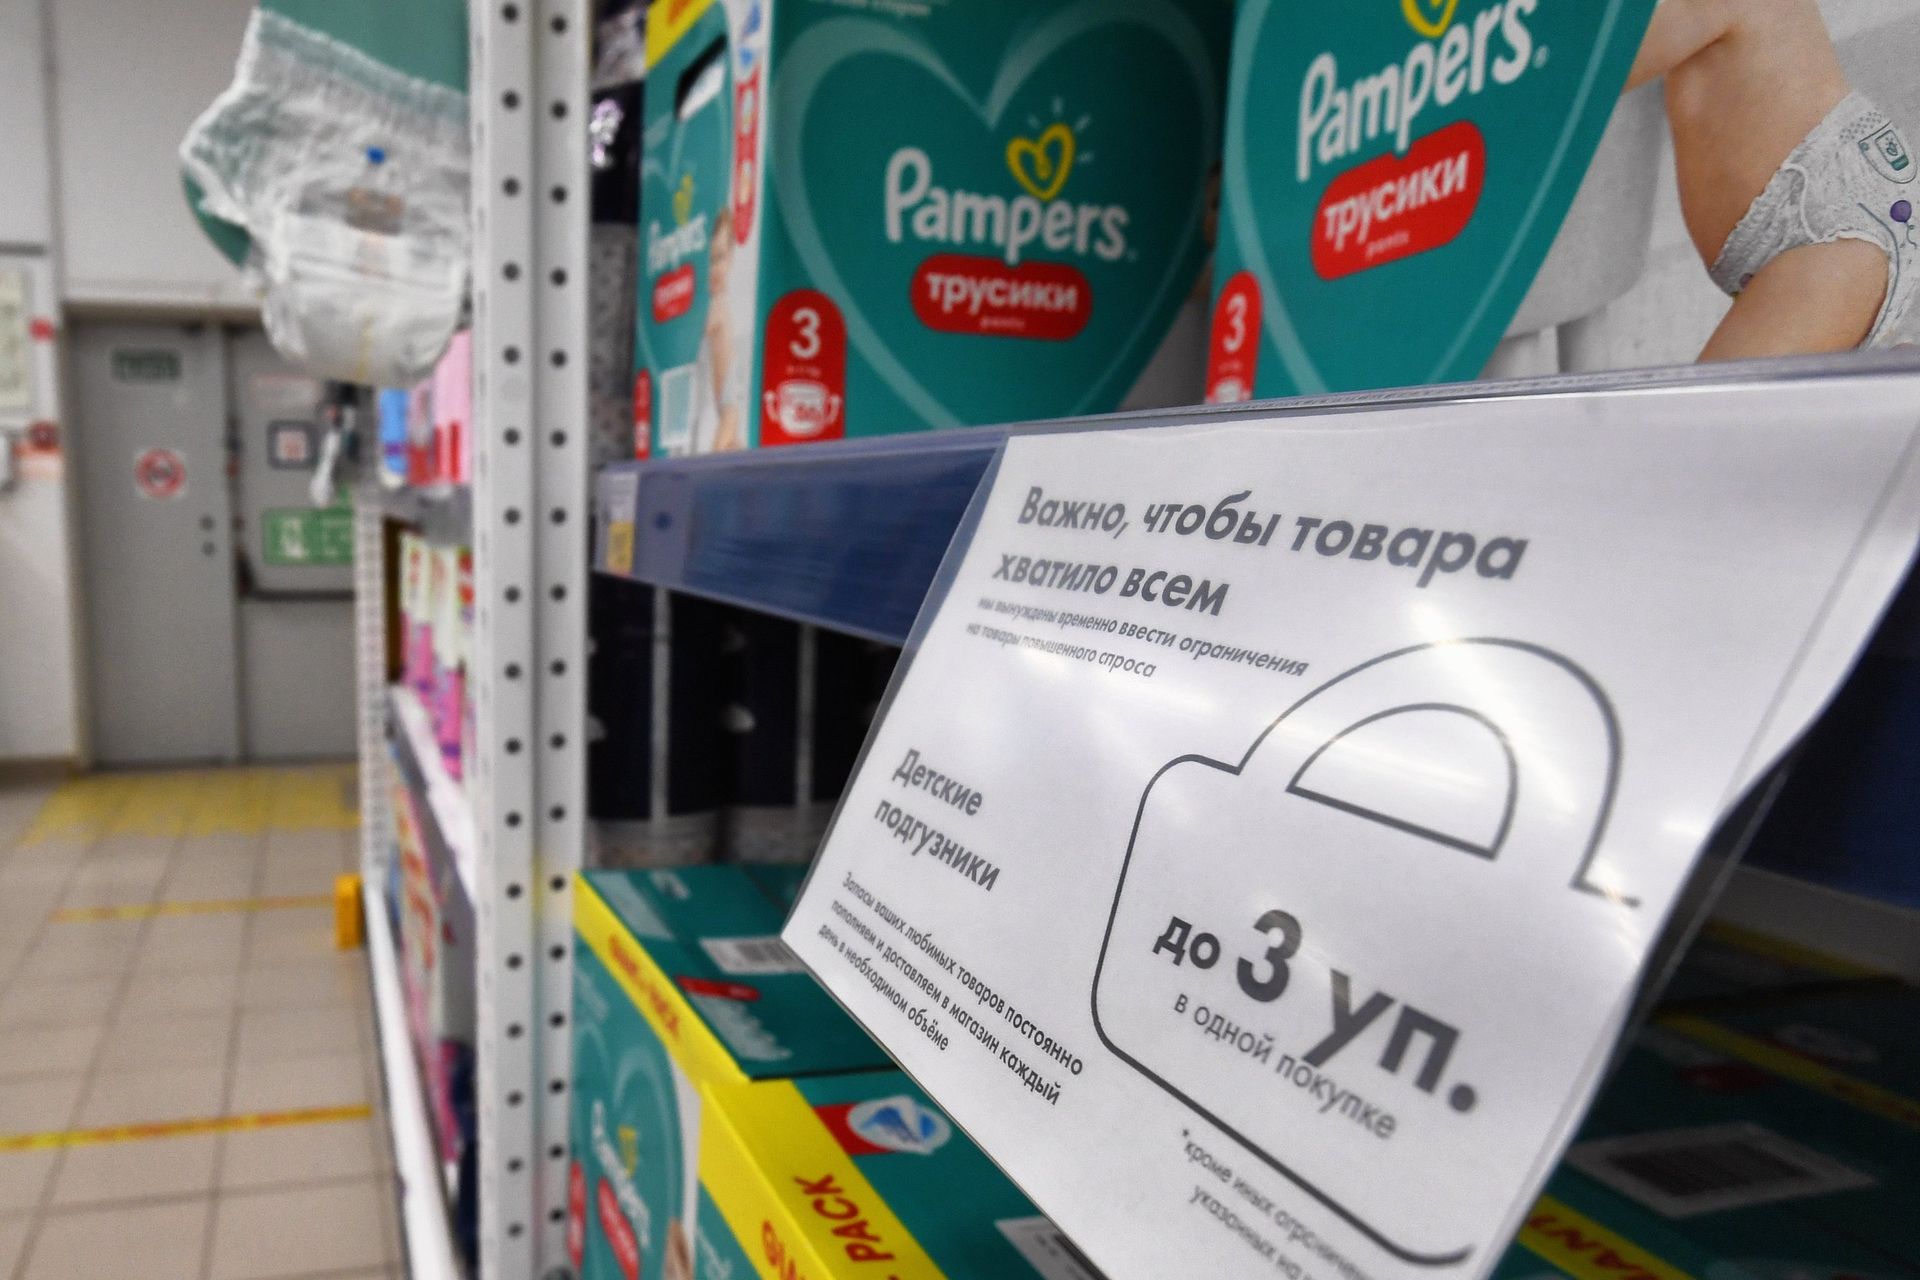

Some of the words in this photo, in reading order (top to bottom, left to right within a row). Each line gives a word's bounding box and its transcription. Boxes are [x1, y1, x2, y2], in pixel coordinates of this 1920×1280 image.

[1296, 0, 1537, 182] Pampers
[885, 146, 1130, 267] Pampers
[1324, 151, 1470, 252] трусики
[789, 308, 822, 360] 3
[926, 272, 1079, 316] трусики
[1223, 293, 1249, 354] 3
[992, 552, 1119, 596] хватило
[1118, 566, 1231, 617] всем
[1017, 486, 1131, 539] Важно,
[1142, 489, 1281, 547] чтобы
[1291, 515, 1530, 588] товара
[982, 625, 1021, 648] товары
[1021, 636, 1098, 663] повышенного
[1098, 651, 1157, 678] спроса
[994, 600, 1058, 623] вынуждены
[1057, 611, 1118, 633] временно
[1118, 622, 1177, 648] ввести
[1179, 637, 1309, 677] ограничения
[891, 749, 984, 816] Детские
[874, 799, 1000, 892] подгузники
[818, 924, 838, 948] день
[839, 942, 846, 953] в
[845, 946, 908, 1014] необходимом
[907, 1007, 949, 1051] объёме
[831, 900, 876, 946] пополняем
[876, 938, 885, 952] и
[881, 946, 942, 1003] доставляем
[941, 995, 950, 1009] в
[949, 1003, 1000, 1054] магазин
[999, 1046, 1062, 1106] каждый
[842, 871, 875, 908] Запасы
[874, 901, 907, 933] ваших
[904, 926, 957, 975] любимых
[956, 966, 1005, 1014] товаров
[1004, 1006, 1083, 1076] постоянно
[1152, 915, 1221, 970] до
[1236, 909, 1303, 1003] 3
[1302, 967, 1477, 1113] уп.
[1174, 994, 1188, 1014] в
[1193, 1004, 1275, 1064] одной
[1275, 1053, 1398, 1140] покупке
[793, 1174, 895, 1263] PACK
